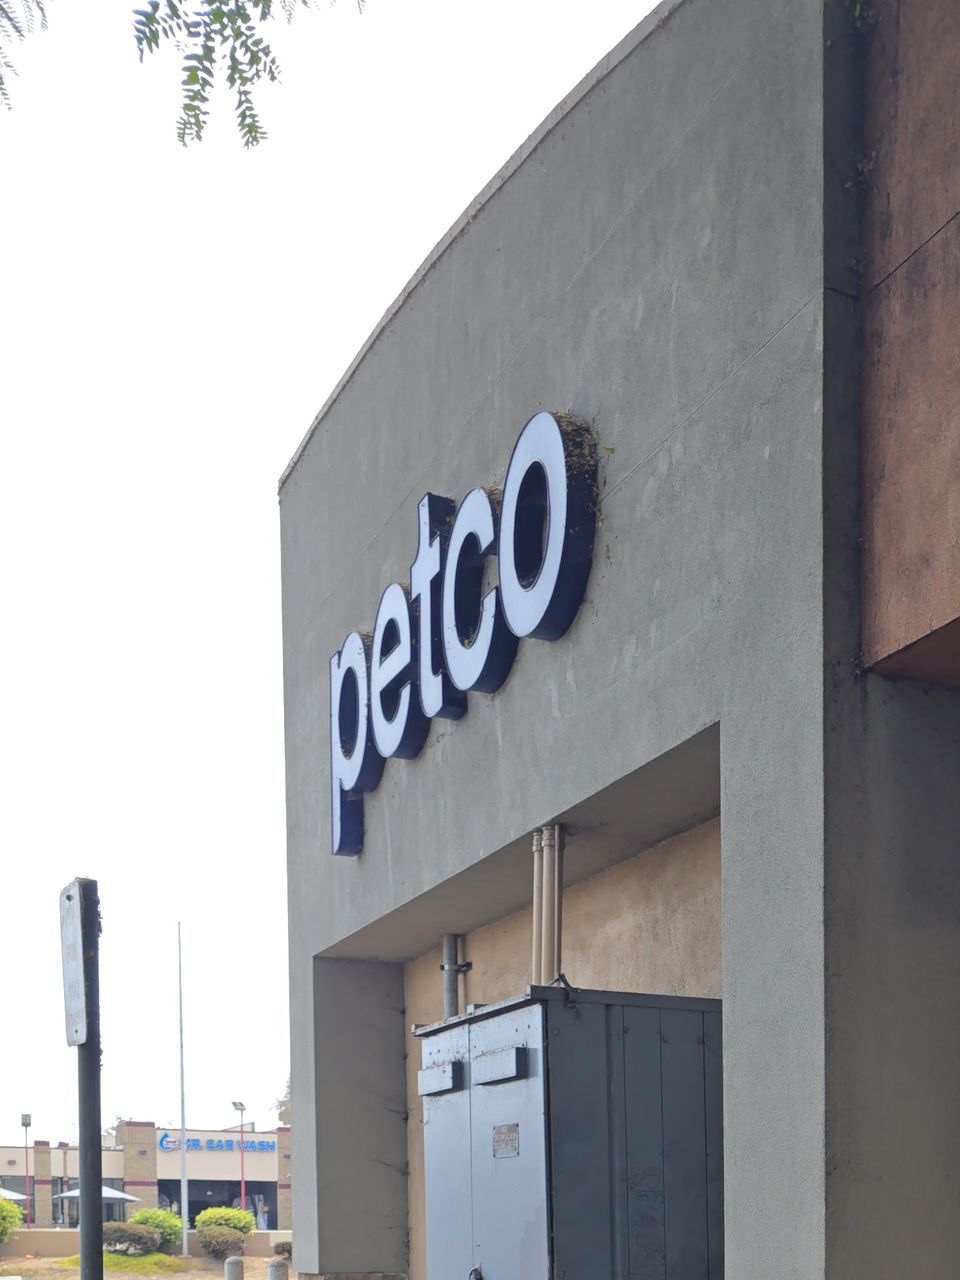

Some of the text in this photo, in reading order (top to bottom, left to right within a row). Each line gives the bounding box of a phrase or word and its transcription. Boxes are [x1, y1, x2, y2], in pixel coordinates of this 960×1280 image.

[329, 410, 580, 856] petco
[206, 1138, 234, 1151] CAR
[237, 1140, 276, 1152] WASH
